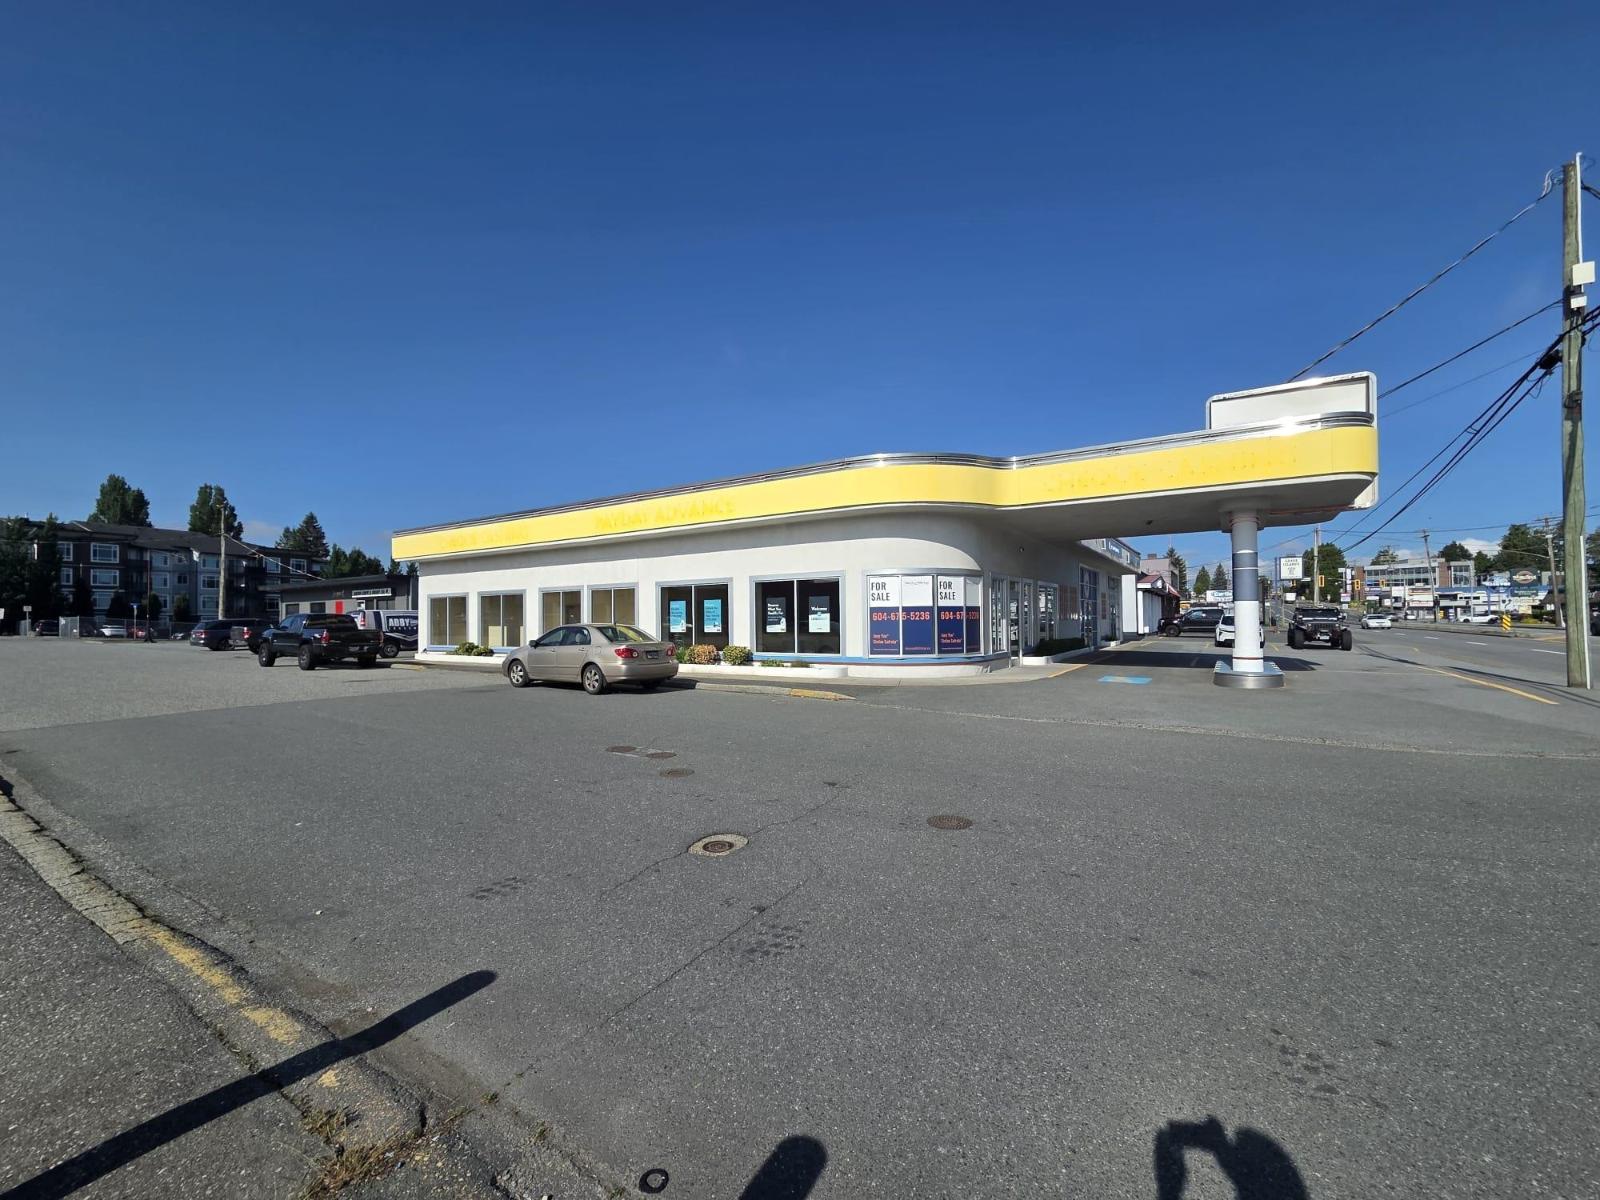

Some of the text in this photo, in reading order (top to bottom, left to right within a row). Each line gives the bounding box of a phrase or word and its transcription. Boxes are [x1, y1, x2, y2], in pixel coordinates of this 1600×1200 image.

[871, 582, 887, 591] FOR
[939, 581, 953, 590] FOR
[871, 592, 890, 602] SALE
[939, 591, 956, 600] SALE
